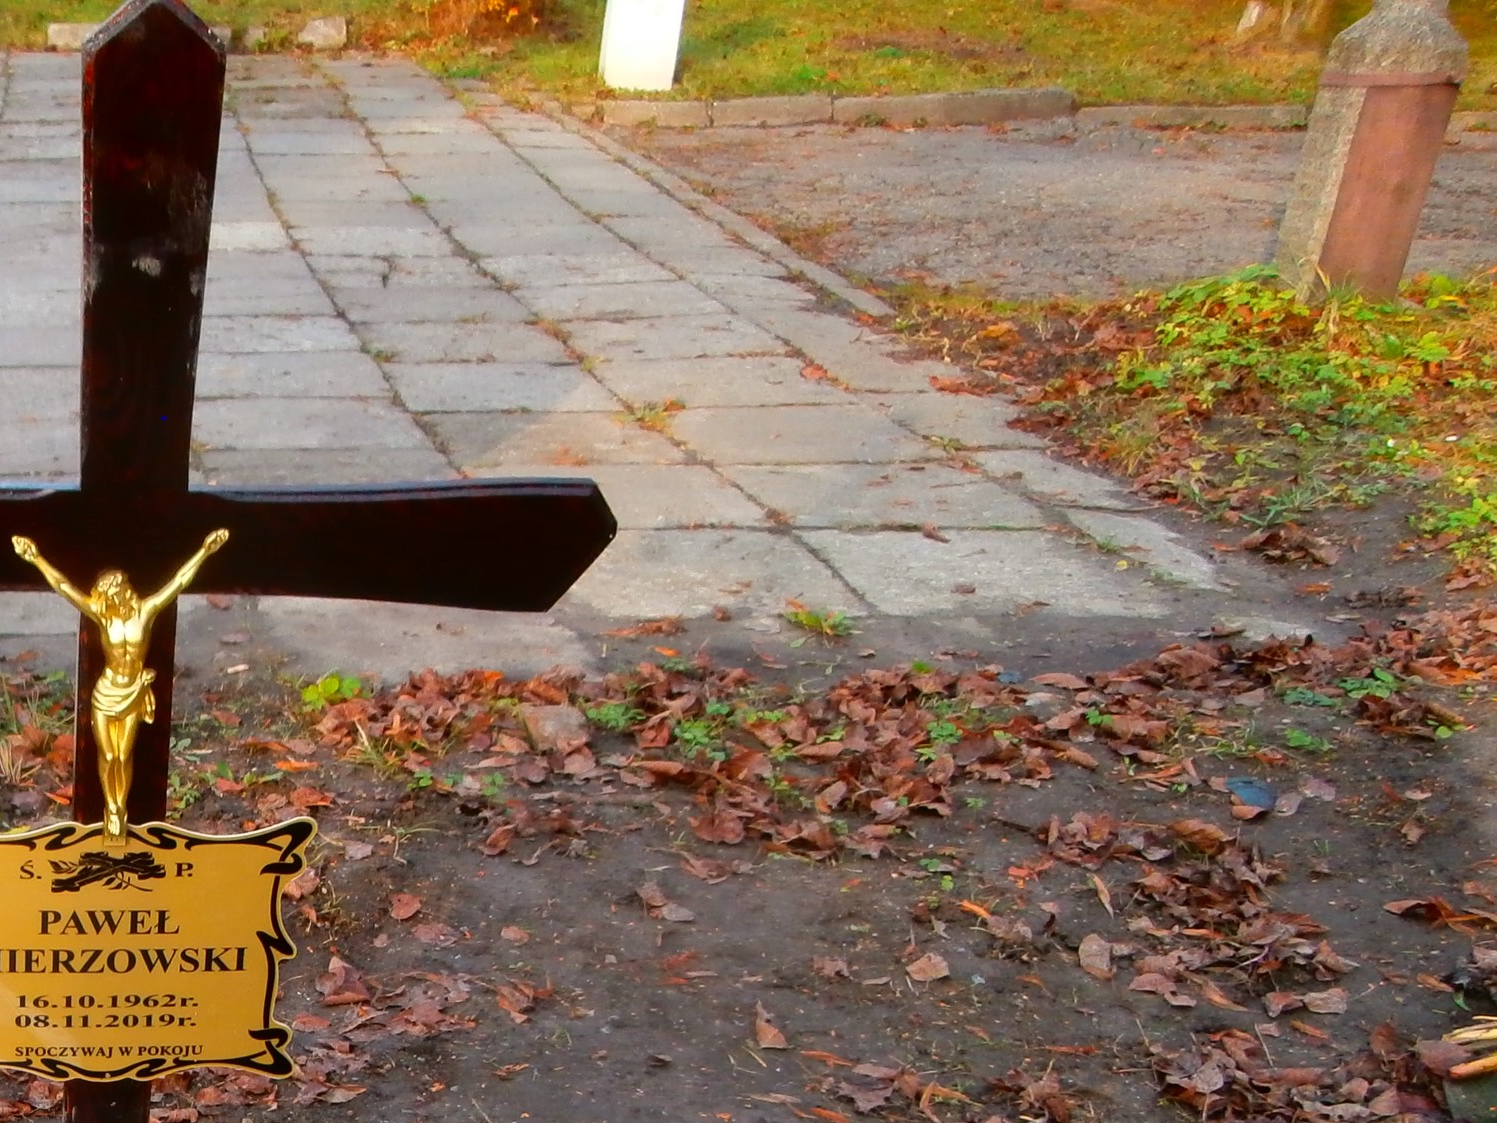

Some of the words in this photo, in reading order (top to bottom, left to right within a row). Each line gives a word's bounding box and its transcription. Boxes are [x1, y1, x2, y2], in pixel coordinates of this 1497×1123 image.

[19, 860, 42, 880] Ś.
[175, 862, 194, 878] P.
[38, 909, 181, 936] PAWEŁ
[15, 994, 199, 1009] 16.10.1962r.
[15, 1013, 197, 1029] 08.11.2019r.
[15, 1045, 113, 1059] SPOCZYWAJ
[117, 1045, 134, 1057] W
[136, 1044, 203, 1058] POKOJU
